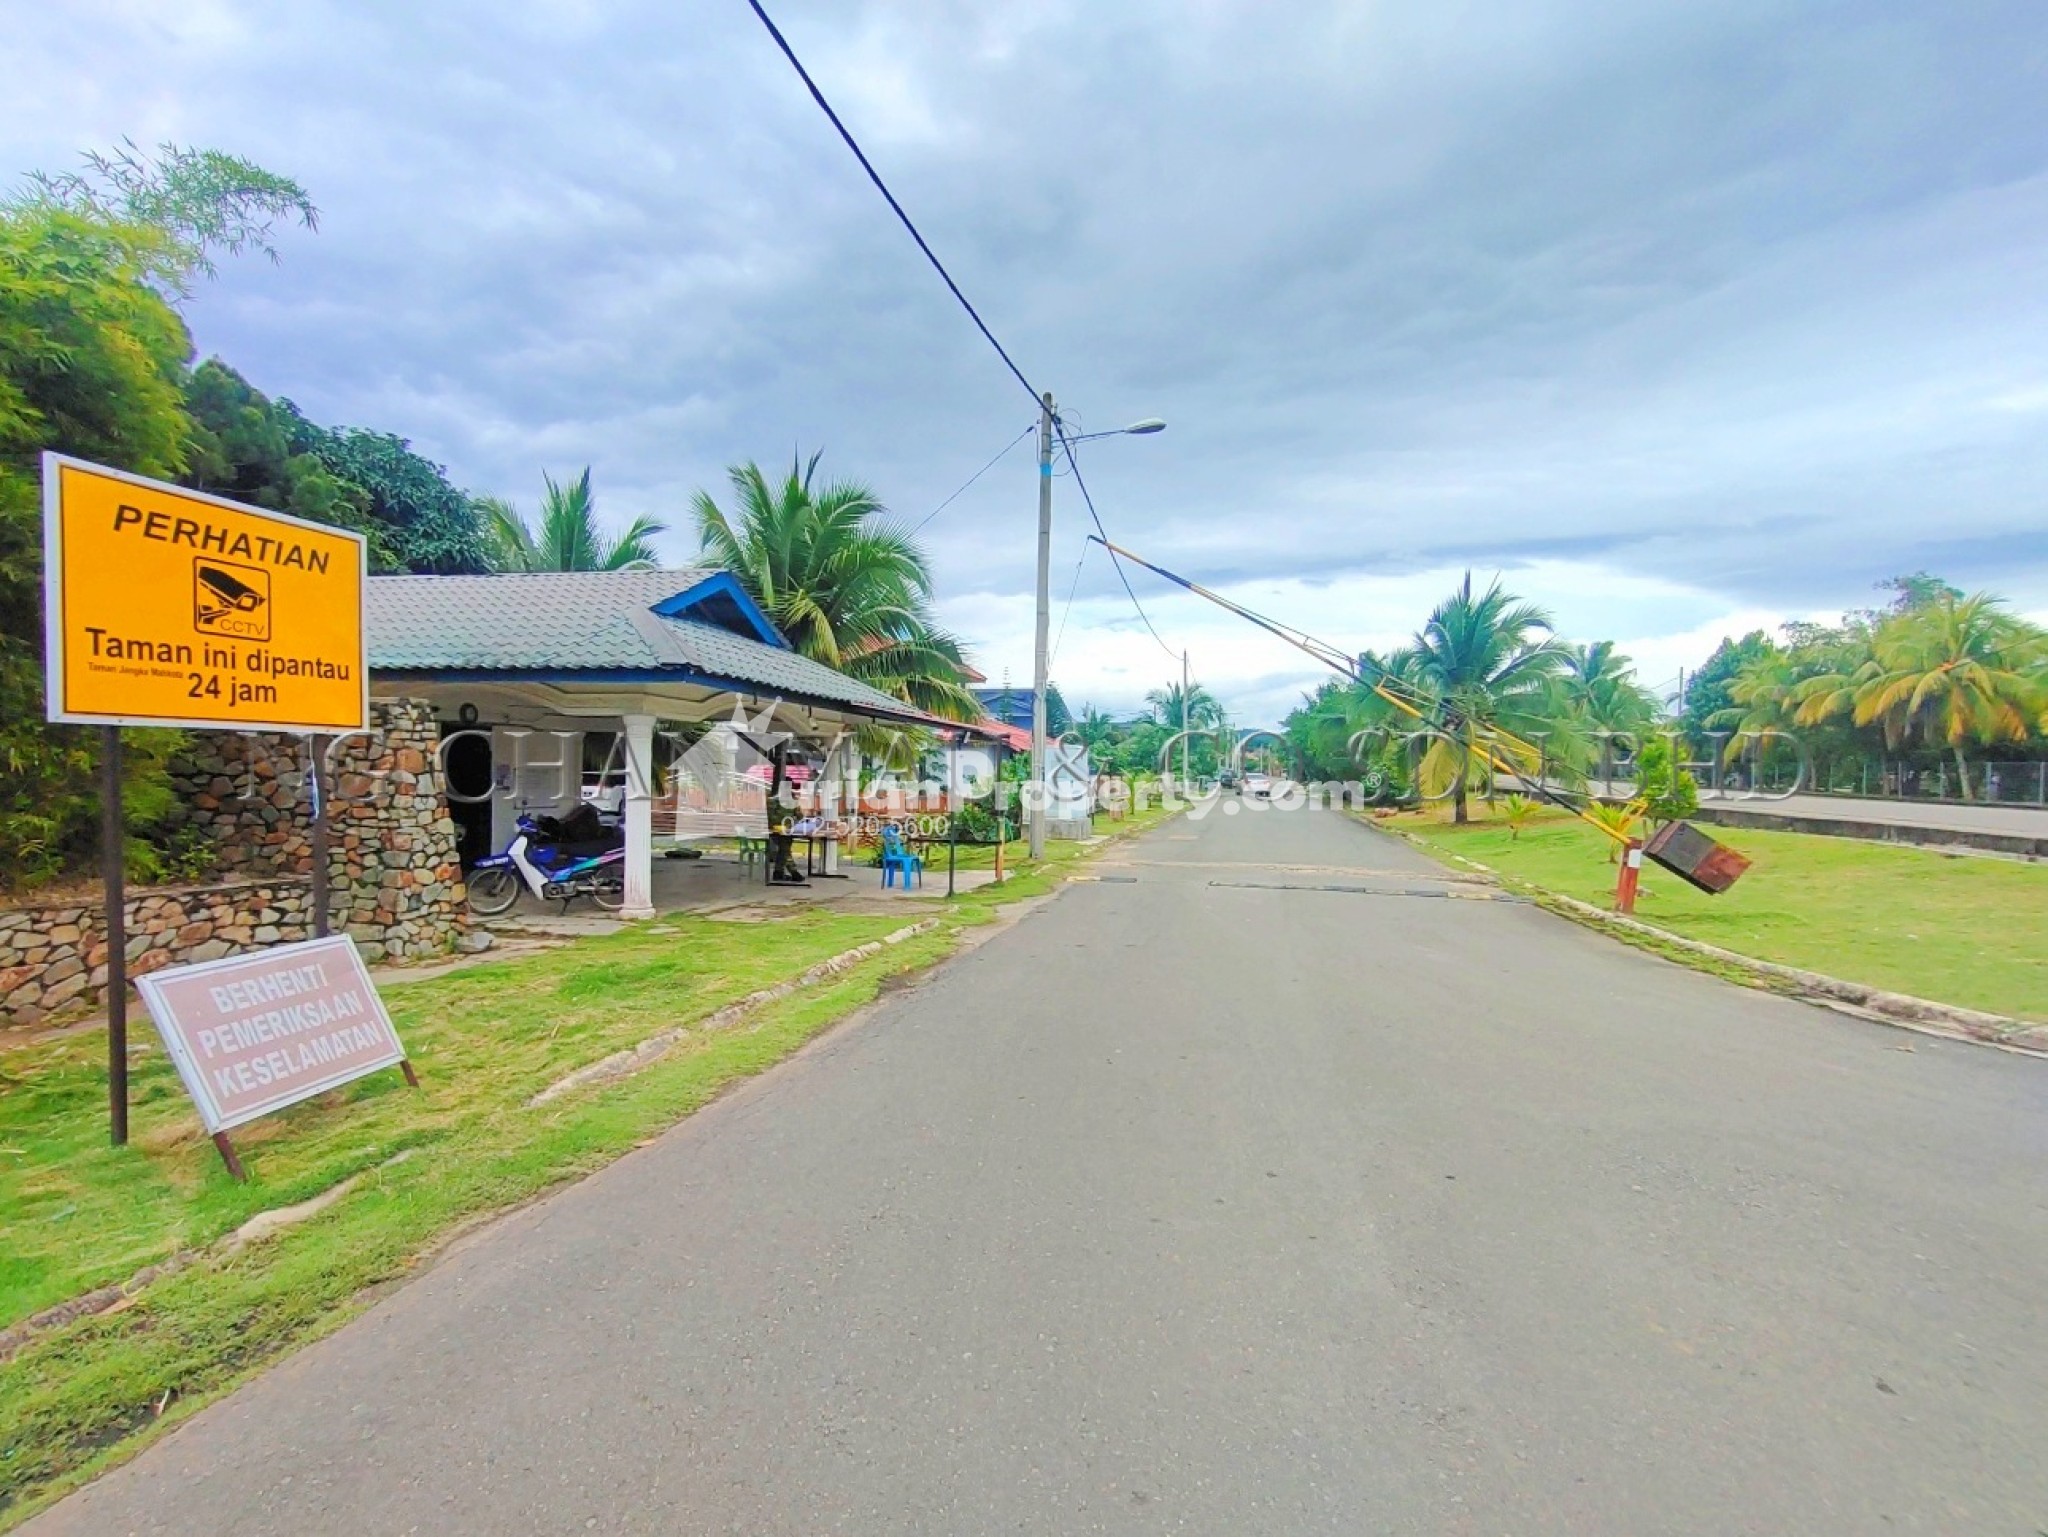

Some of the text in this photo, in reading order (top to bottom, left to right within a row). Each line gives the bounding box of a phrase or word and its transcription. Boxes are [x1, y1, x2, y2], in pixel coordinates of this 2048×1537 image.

[113, 504, 330, 575] PERHATIAN
[220, 618, 265, 635] CCTV
[85, 627, 350, 681] Taman ini dipantau
[188, 672, 278, 707] 24 jam
[209, 963, 328, 1014] BERHENTI
[197, 990, 364, 1058] PEMERIKSAAN
[213, 1020, 382, 1099] KESELAMATAN
